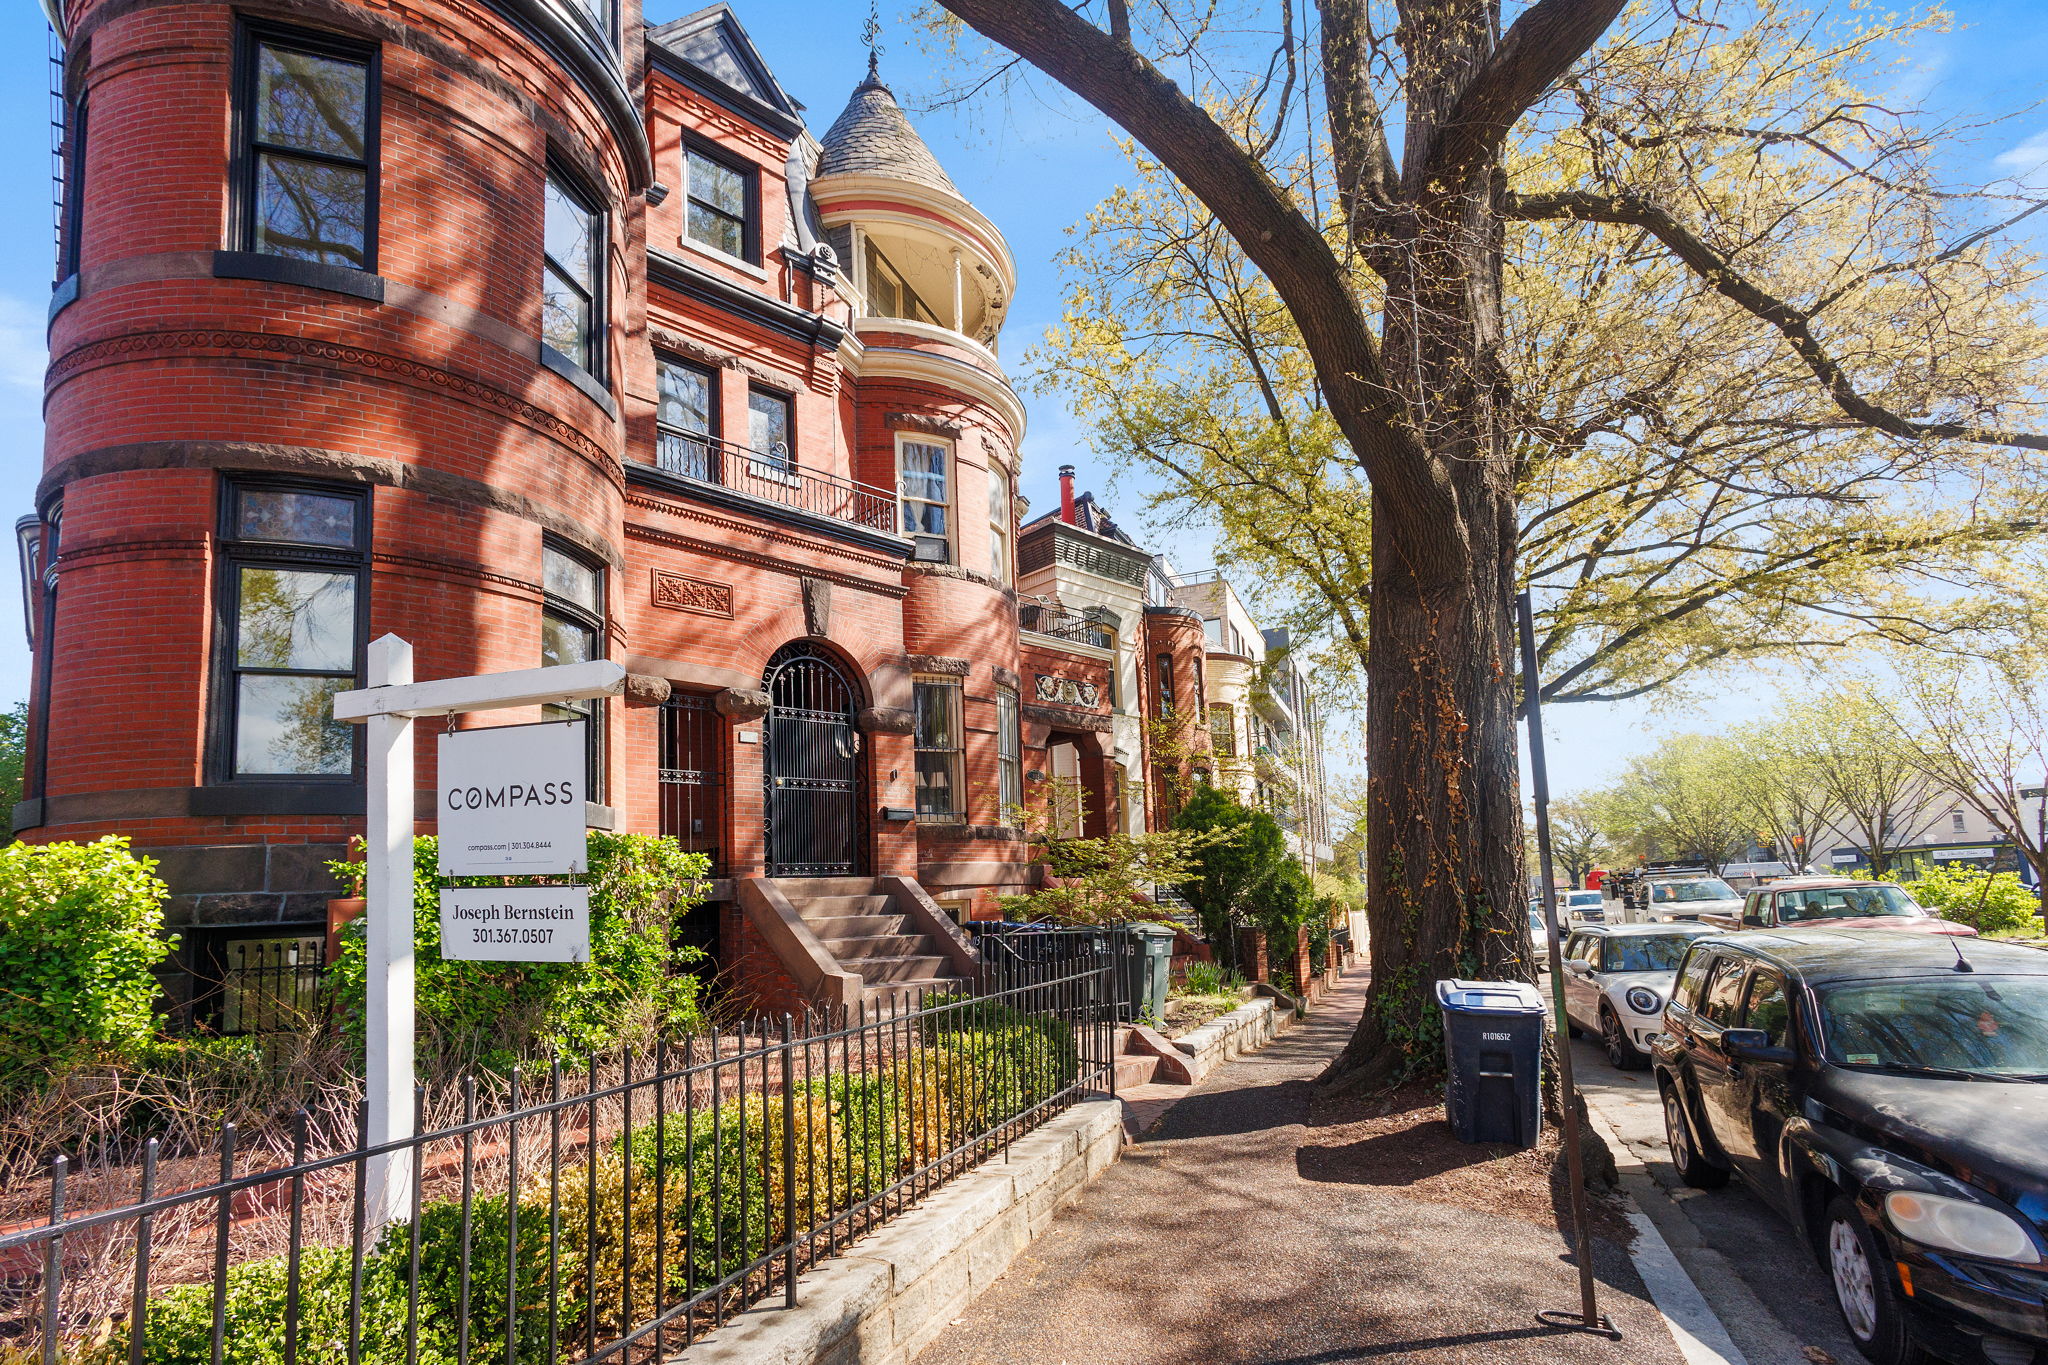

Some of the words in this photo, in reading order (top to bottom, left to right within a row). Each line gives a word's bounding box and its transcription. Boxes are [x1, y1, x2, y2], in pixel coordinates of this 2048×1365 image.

[448, 781, 573, 811] COMPASS
[467, 843, 507, 852] compass.com
[511, 841, 552, 850] 301.304.8444
[452, 904, 500, 924] Joseph
[504, 904, 575, 920] Bernstein
[472, 928, 554, 944] 301.367.0507
[1482, 1032, 1511, 1041] R1016512
